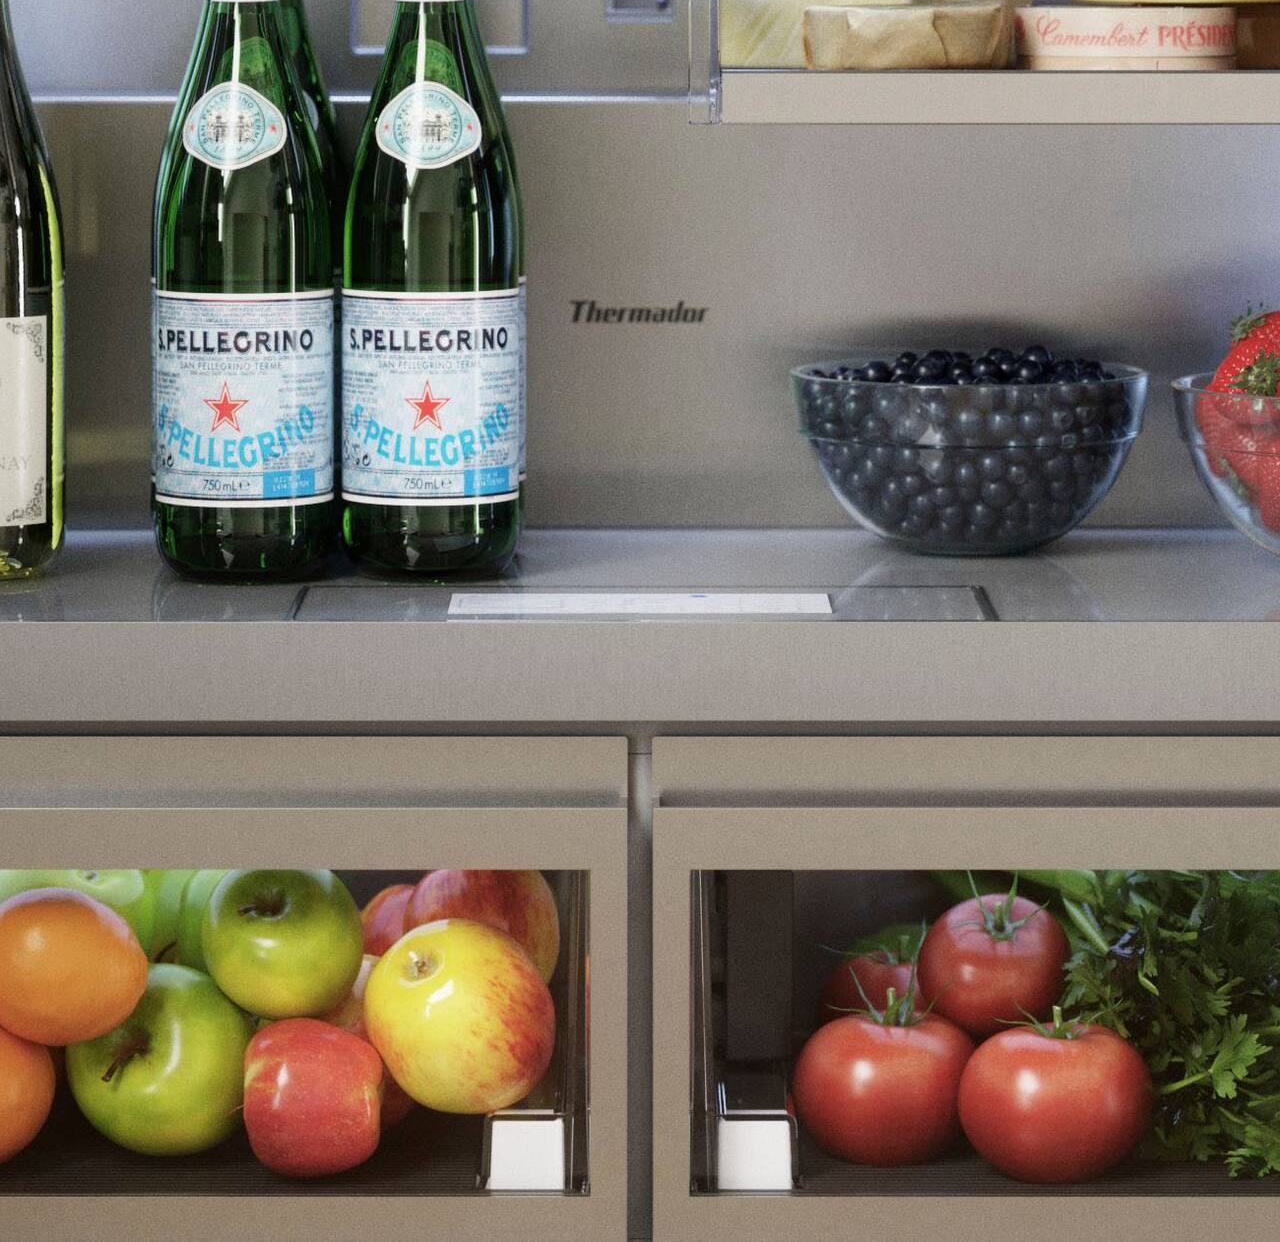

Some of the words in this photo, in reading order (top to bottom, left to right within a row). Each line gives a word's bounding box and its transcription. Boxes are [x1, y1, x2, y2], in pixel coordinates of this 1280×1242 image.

[1036, 15, 1148, 47] Camembert
[1157, 21, 1237, 51] PRÉSID
[570, 300, 709, 323] Thermador
[159, 328, 314, 354] S.PELLEGRINO
[350, 326, 509, 352] S.PELLEGRINO
[197, 361, 251, 371] PELLEGRINO
[203, 479, 221, 491] 750
[404, 478, 423, 489] 750
